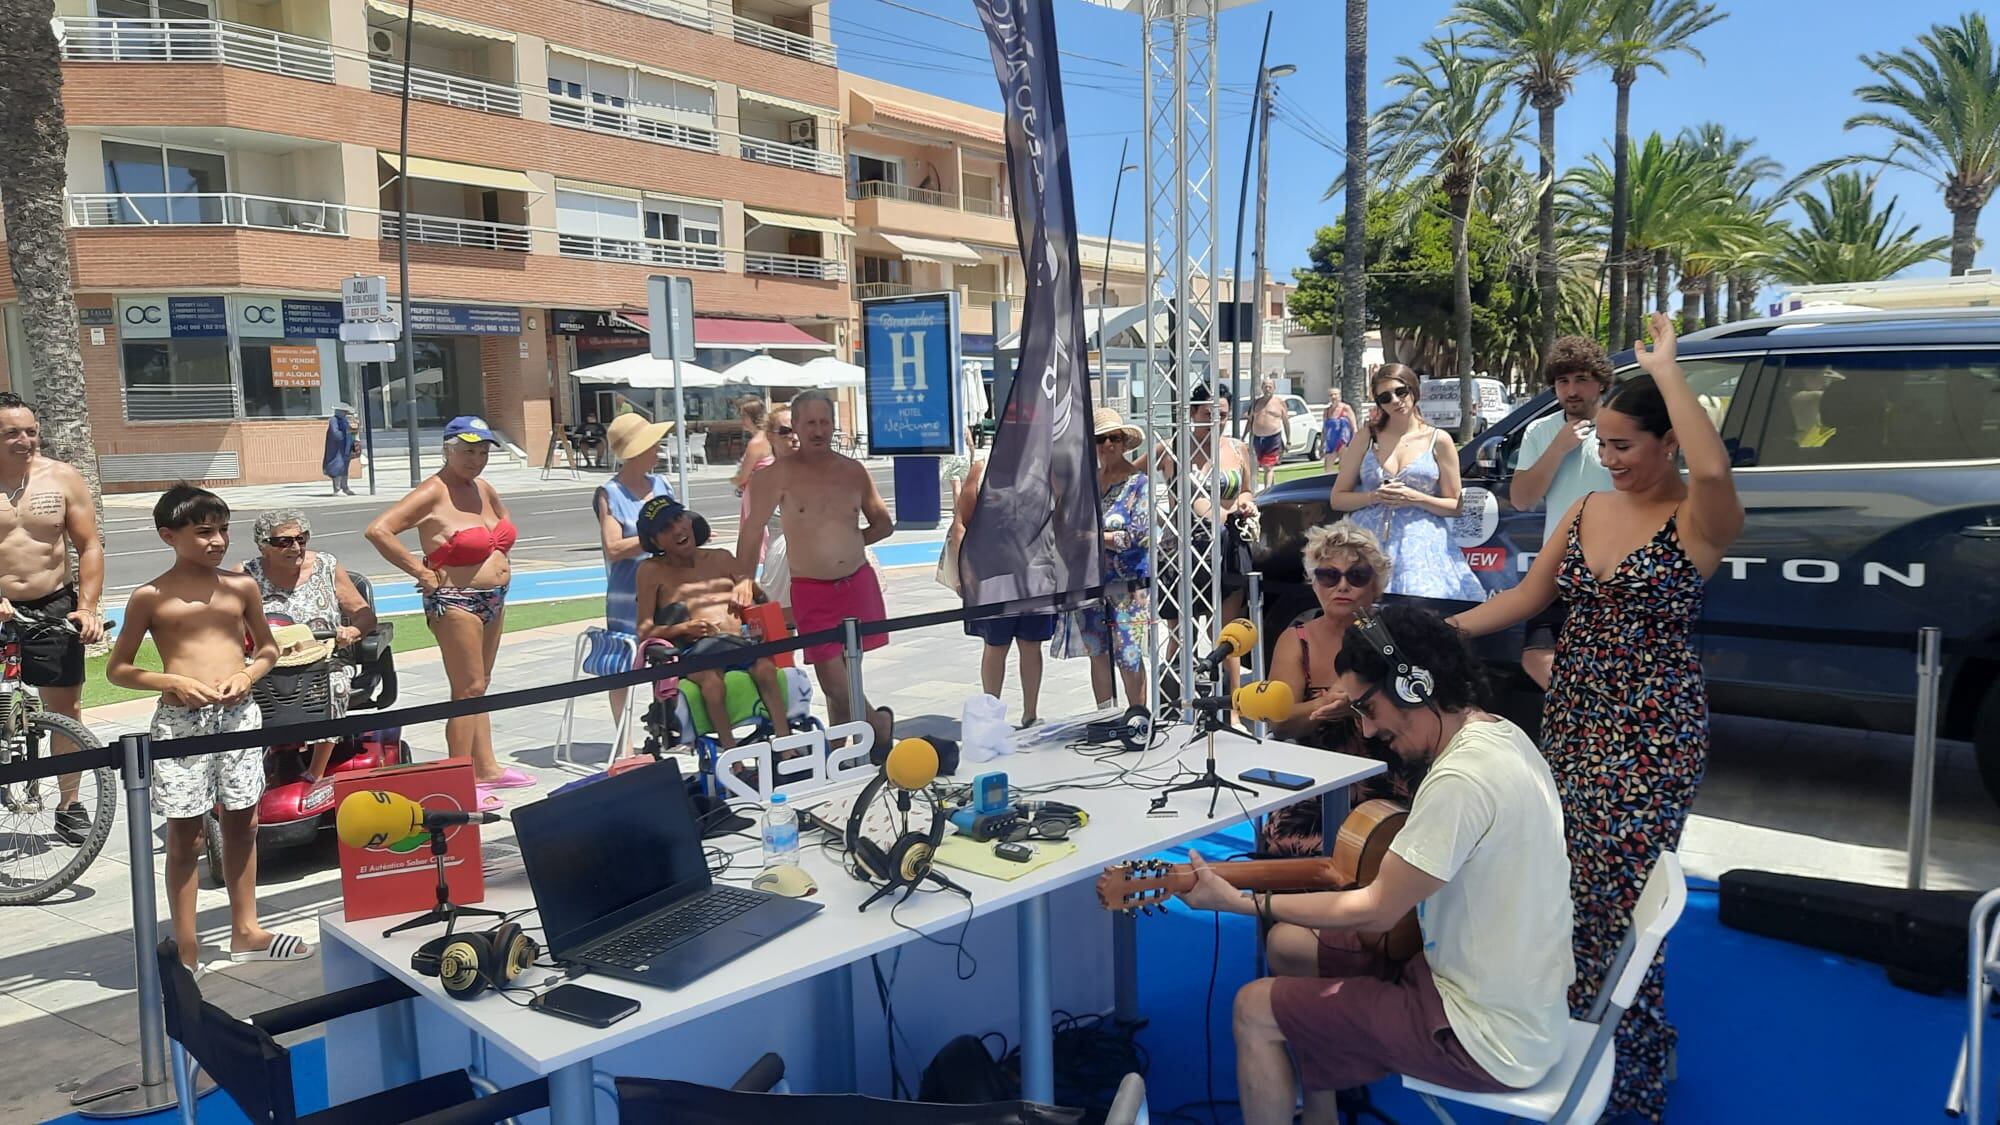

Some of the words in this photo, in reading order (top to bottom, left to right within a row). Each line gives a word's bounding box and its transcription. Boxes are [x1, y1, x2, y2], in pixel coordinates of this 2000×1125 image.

[353, 280, 368, 294] AQUÍ
[126, 305, 161, 324] OC
[244, 305, 276, 323] OC
[596, 314, 606, 327] A
[889, 331, 928, 391] H
[899, 408, 922, 417] HOTEL
[359, 865, 368, 873] El
[369, 861, 405, 872] Auténtico
[406, 858, 428, 867] Sabor
